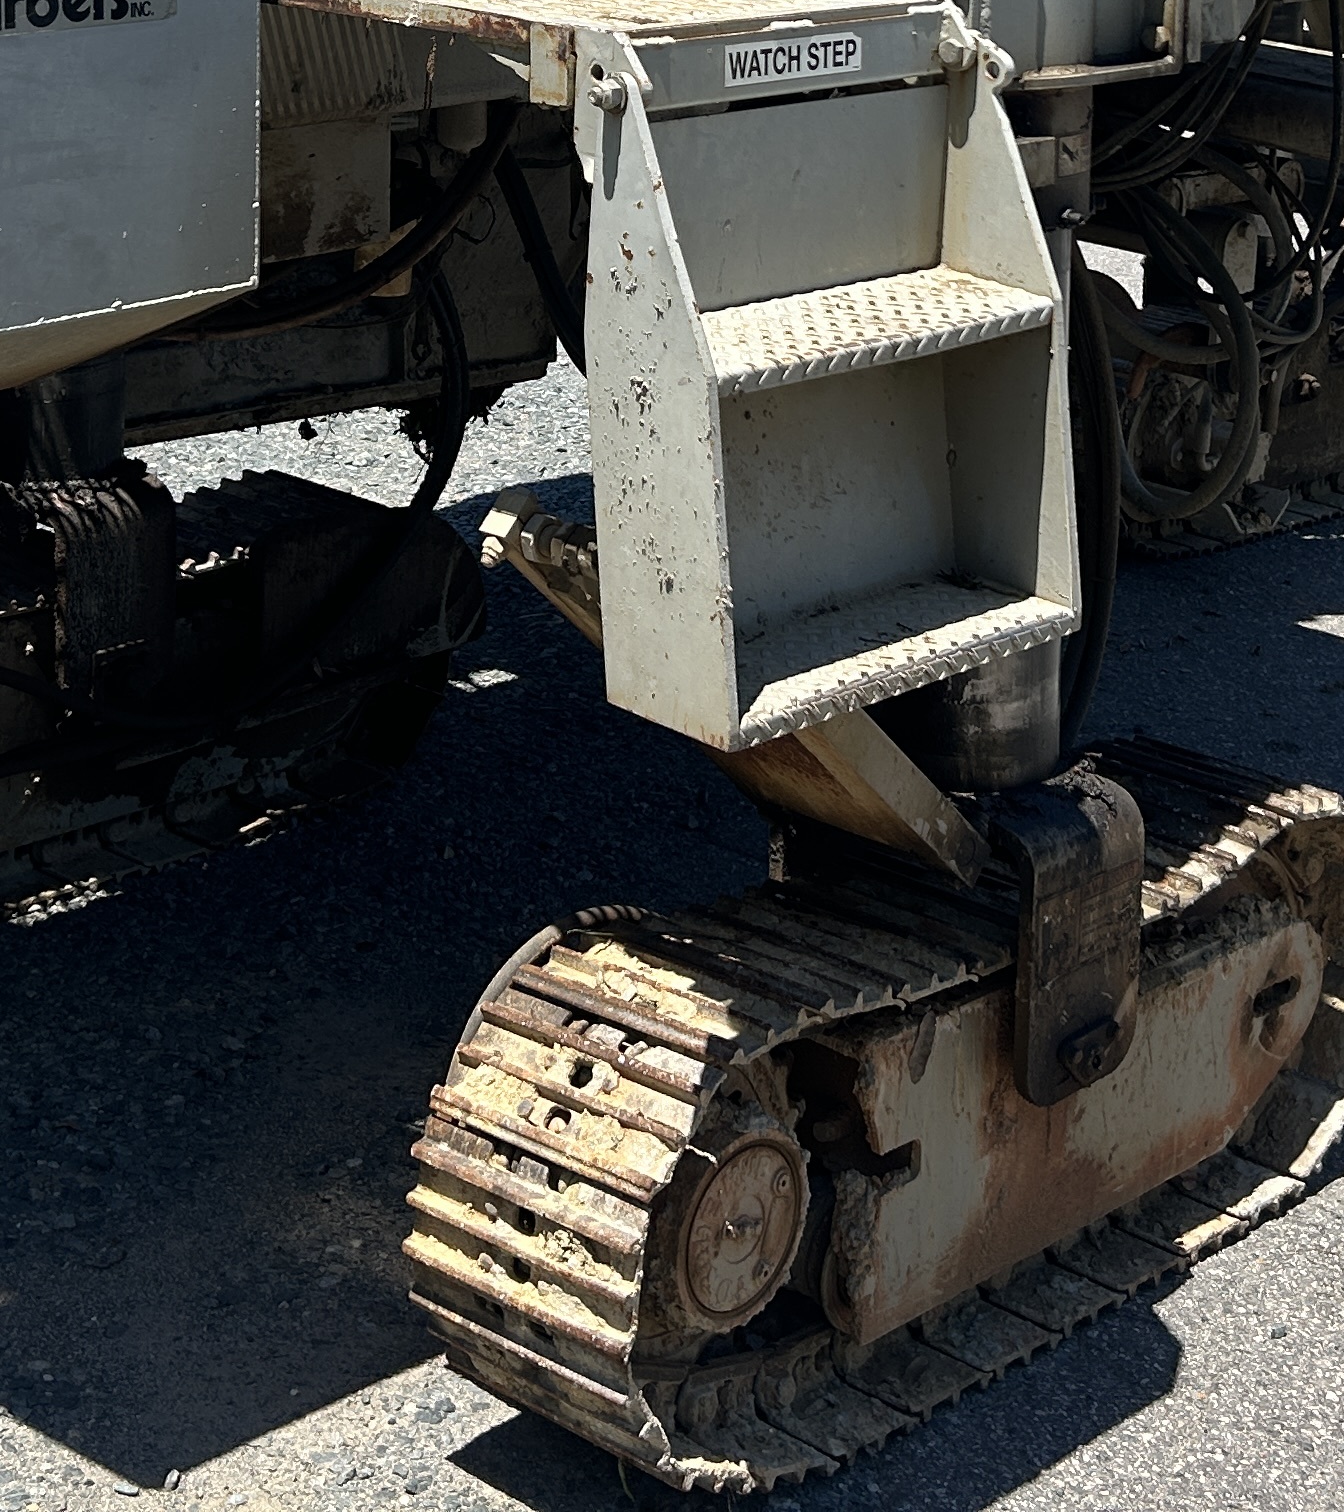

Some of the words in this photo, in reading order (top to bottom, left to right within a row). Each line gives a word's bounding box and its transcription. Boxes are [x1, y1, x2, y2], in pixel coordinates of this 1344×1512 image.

[130, 0, 155, 18] INC.
[728, 44, 801, 80] WATCH
[806, 38, 857, 70] STEP
